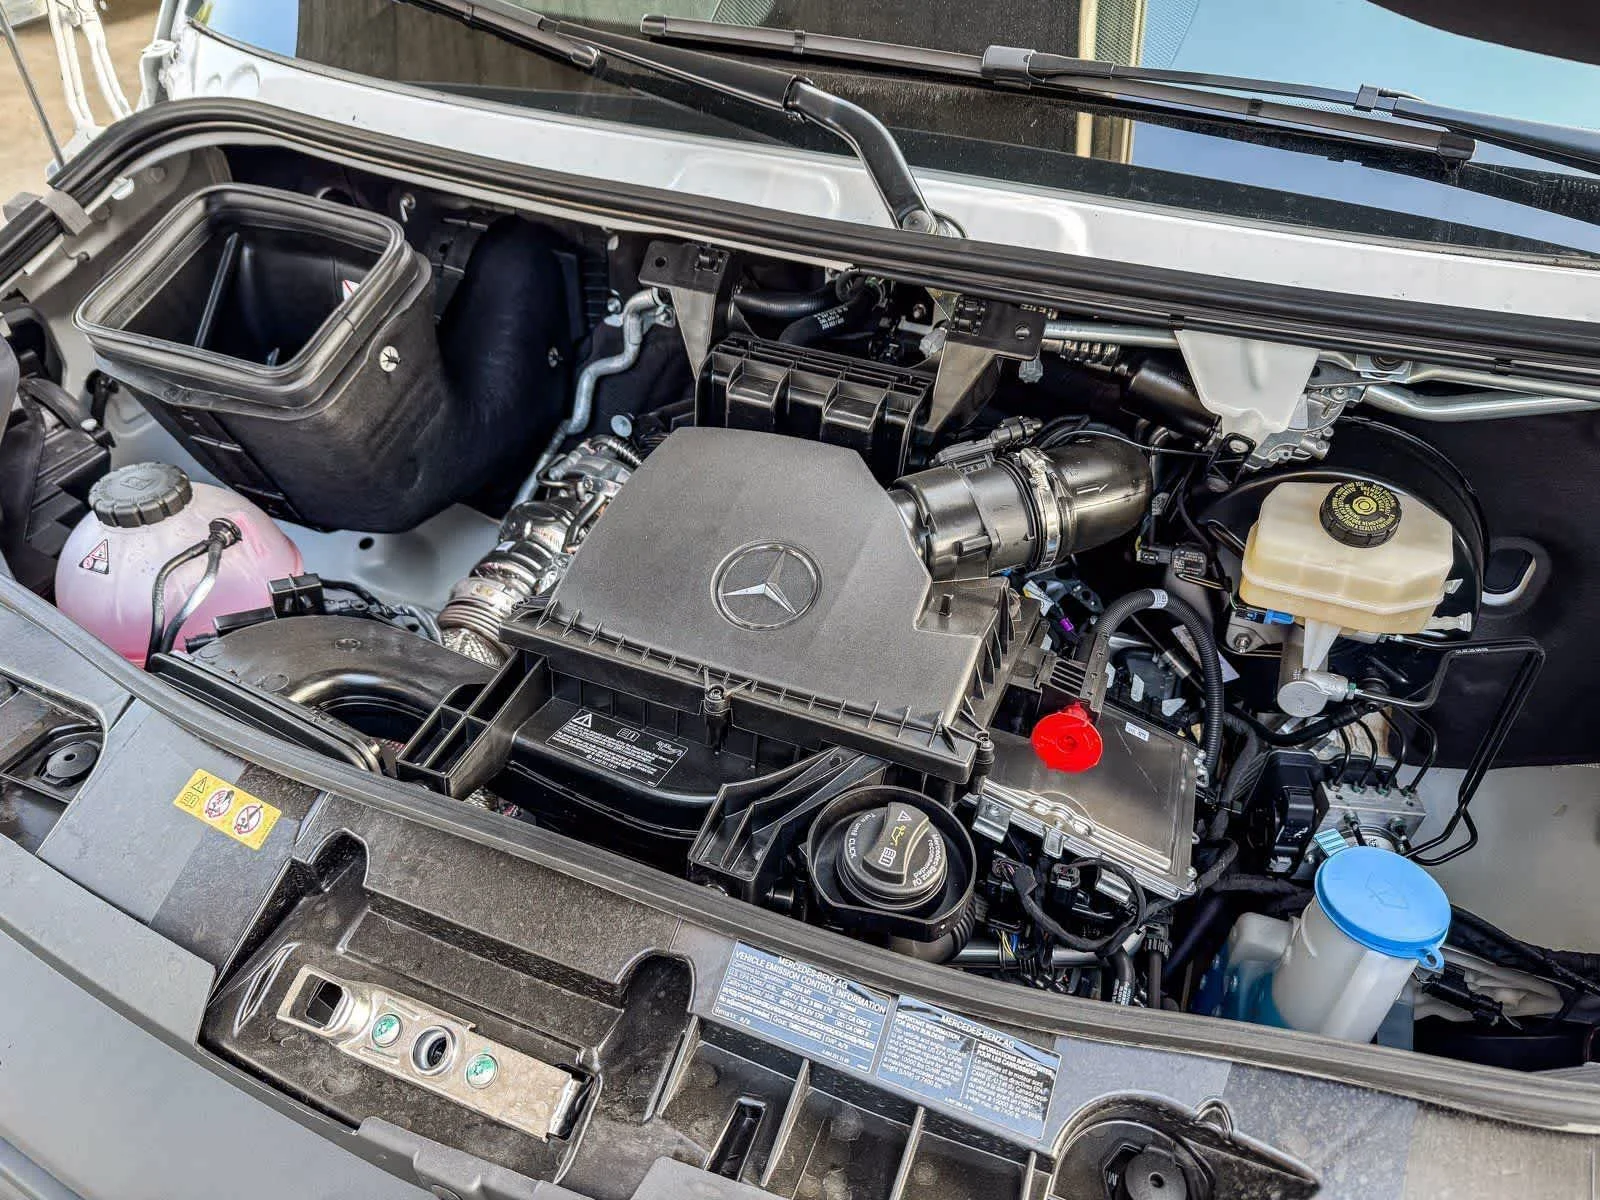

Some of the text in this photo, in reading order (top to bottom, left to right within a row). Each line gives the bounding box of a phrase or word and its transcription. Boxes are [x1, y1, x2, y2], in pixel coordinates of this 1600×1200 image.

[849, 838, 857, 859] CLICK
[735, 950, 886, 1013] VEHICLE EMISSION CONTROL INFORMATION
[777, 956, 848, 989] MERCEDES-BENZ AG
[925, 1023, 959, 1040] INFORMATION
[940, 1014, 1014, 1049] MERCEDES-BENZ AG
[976, 1049, 991, 1059] POUR
